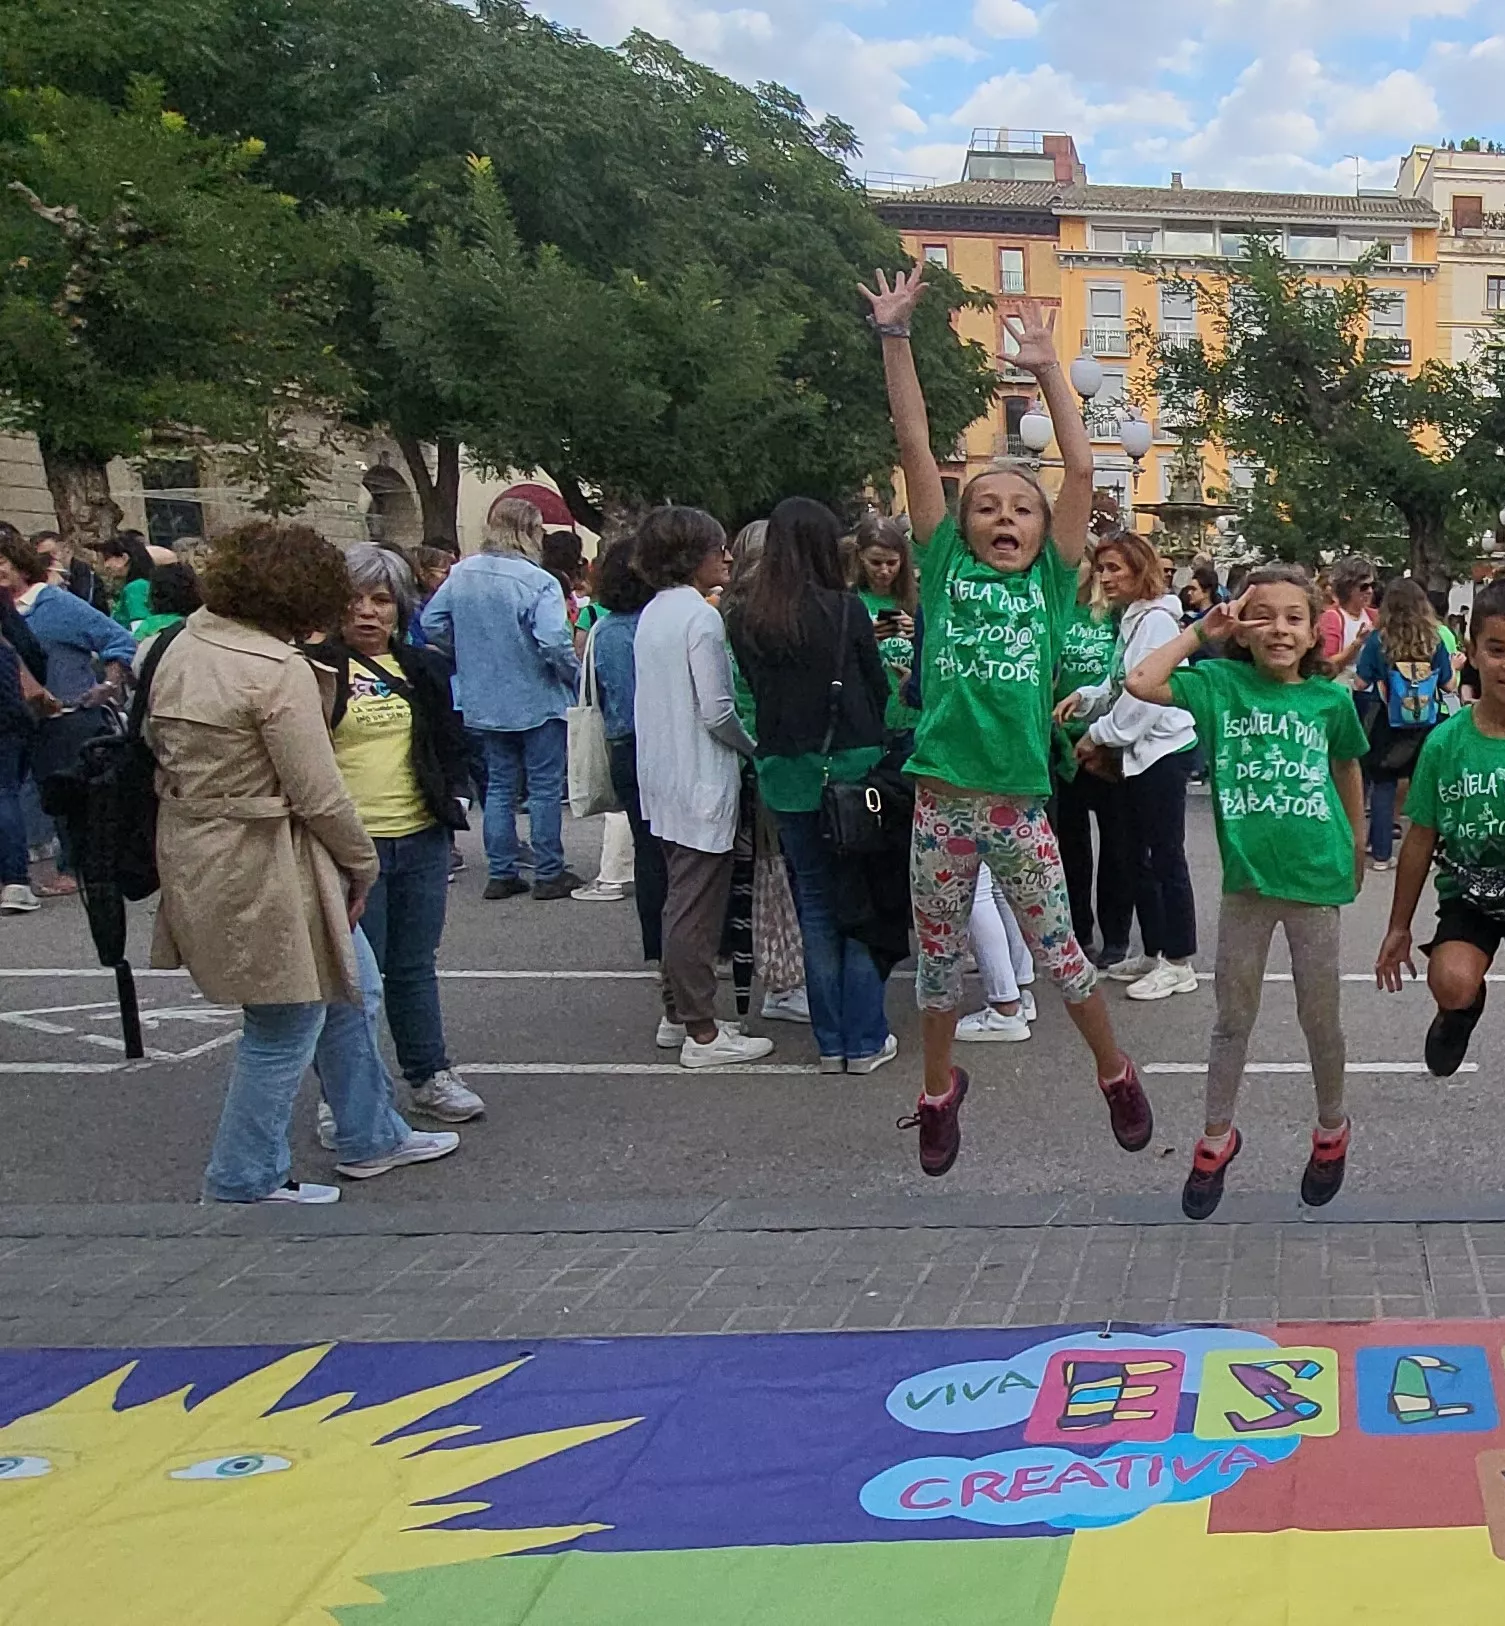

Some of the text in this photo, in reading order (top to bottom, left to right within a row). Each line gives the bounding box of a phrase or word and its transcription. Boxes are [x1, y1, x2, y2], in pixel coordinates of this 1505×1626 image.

[1223, 710, 1289, 740] ESCUELA
[1236, 760, 1262, 780] DE
[1222, 795, 1277, 817] PARA
[1457, 822, 1477, 839] DE
[906, 1371, 1040, 1411] VIVA
[900, 1445, 1278, 1510] CREATIVA
